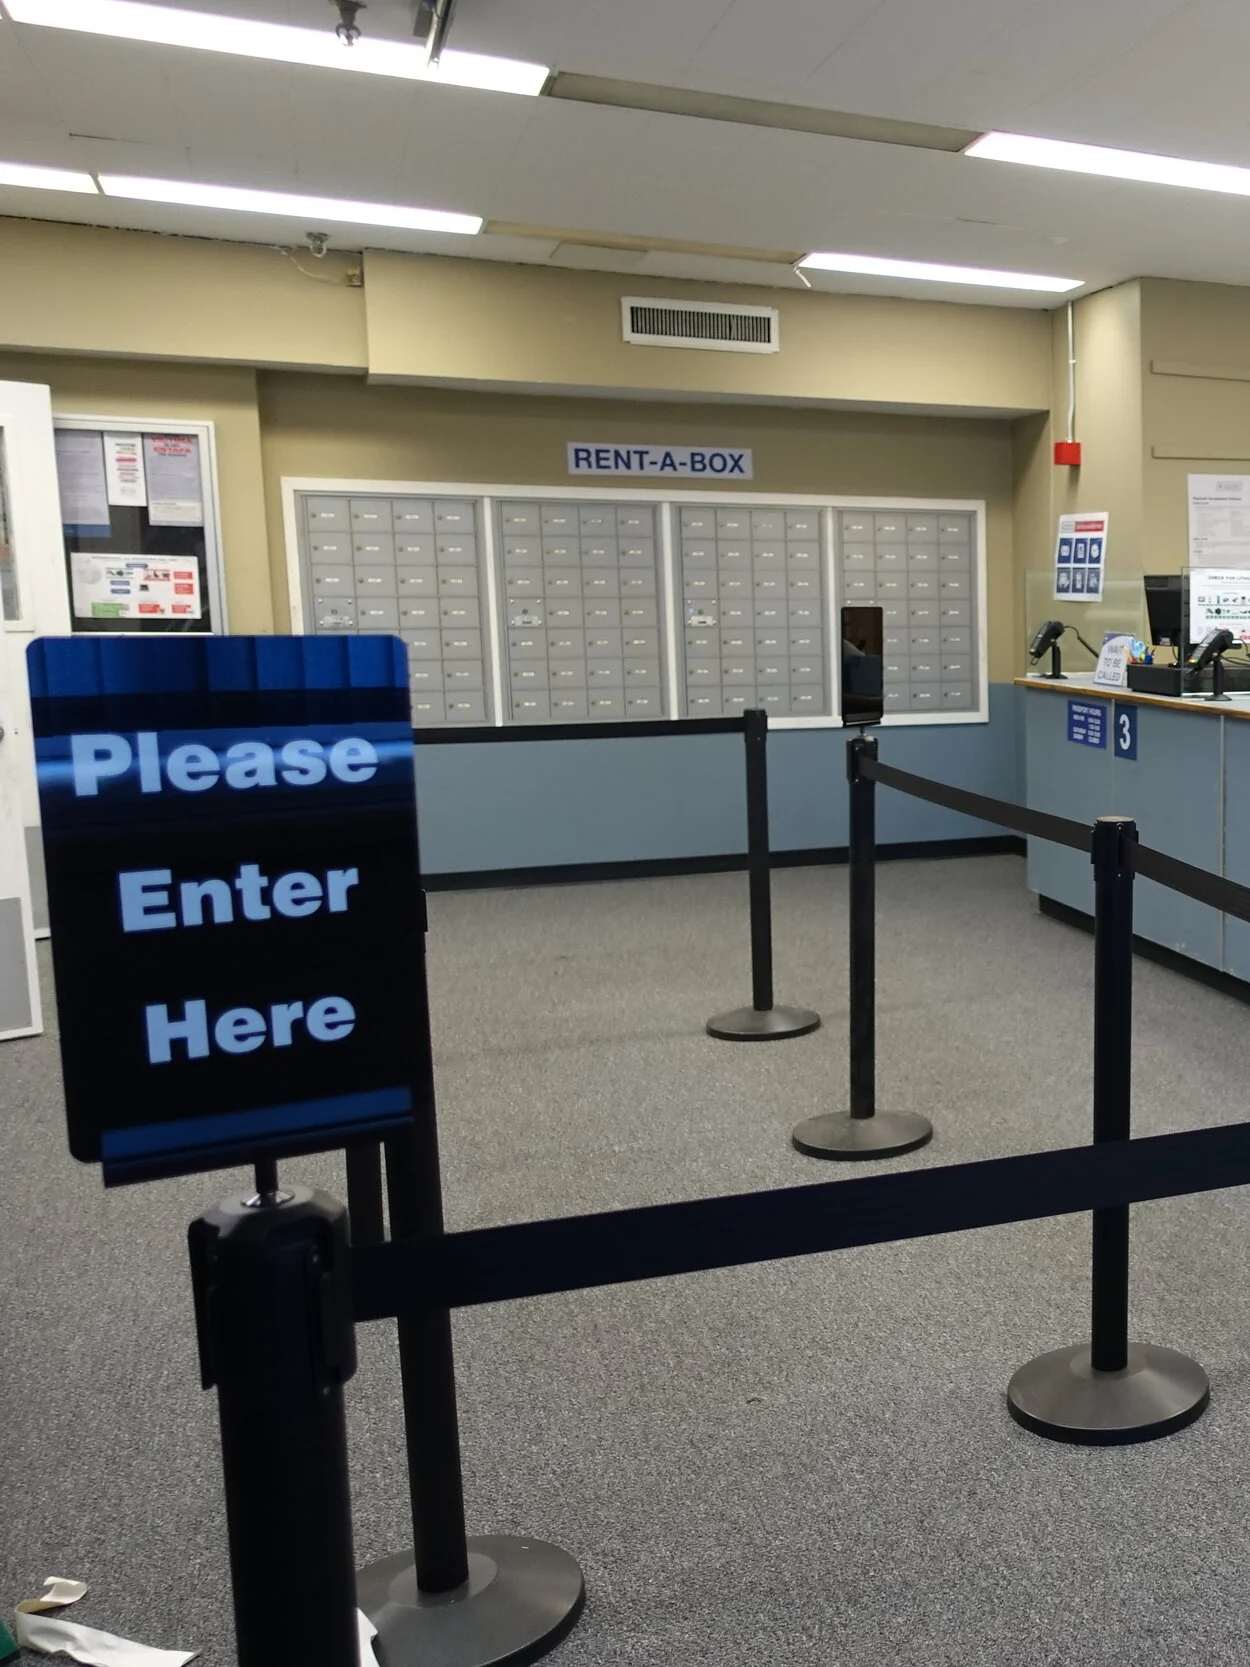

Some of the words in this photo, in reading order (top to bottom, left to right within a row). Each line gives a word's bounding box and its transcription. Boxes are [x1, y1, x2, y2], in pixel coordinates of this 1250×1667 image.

[573, 448, 745, 473] RENT-A-BOX
[70, 731, 379, 797] Please
[1120, 714, 1130, 750] 3
[118, 863, 359, 933] Enter
[145, 996, 356, 1065] Here
